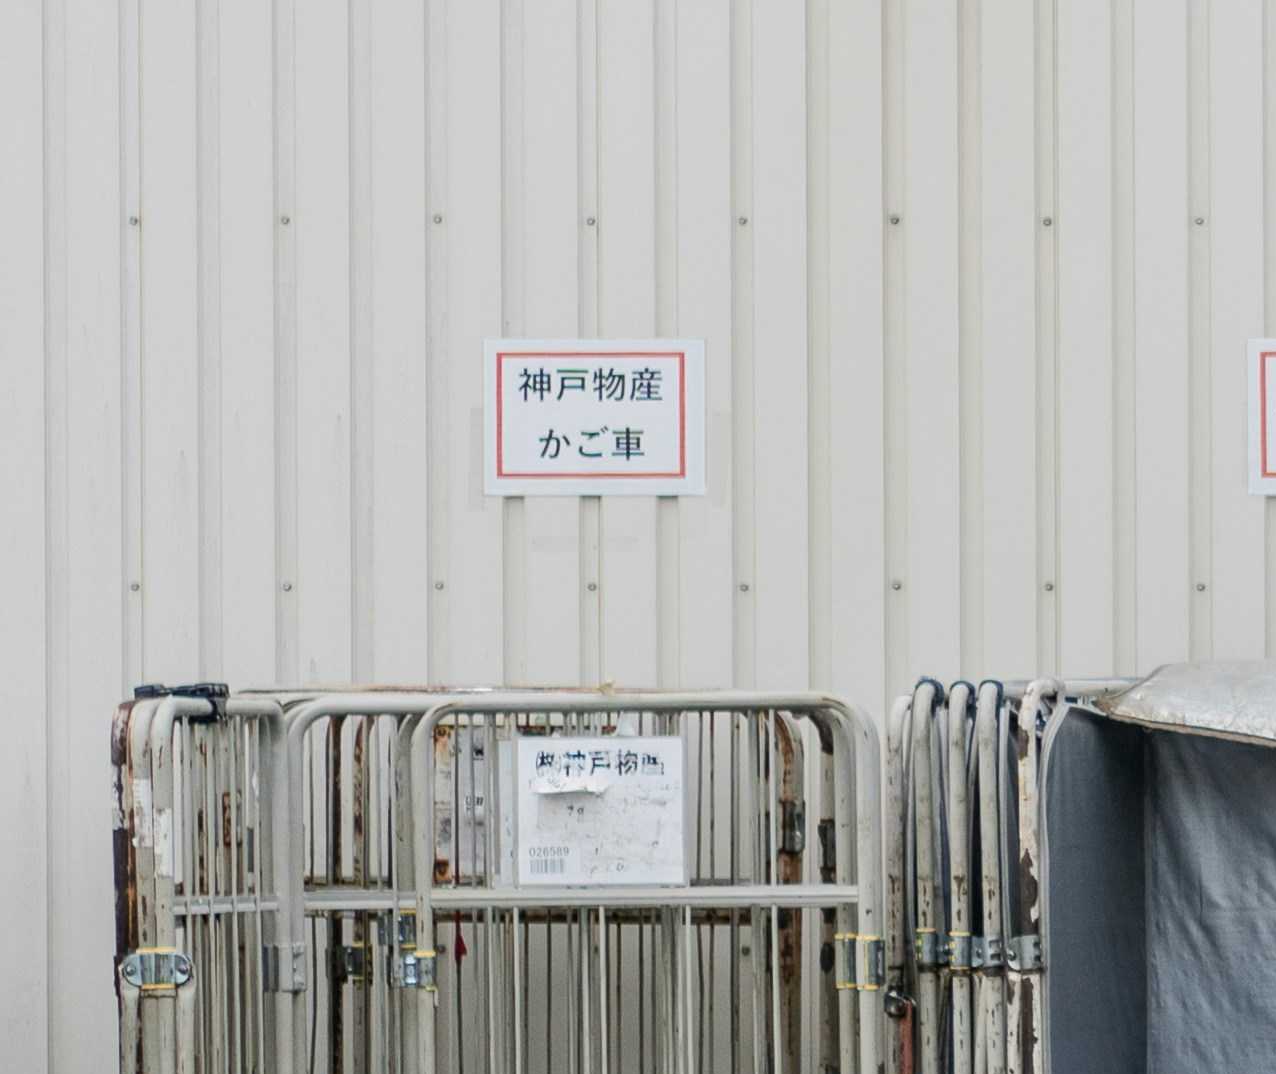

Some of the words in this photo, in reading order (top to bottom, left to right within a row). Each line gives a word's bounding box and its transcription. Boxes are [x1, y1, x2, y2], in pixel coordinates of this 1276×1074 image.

[518, 367, 663, 402] 神戸物産
[539, 426, 645, 461] かご車
